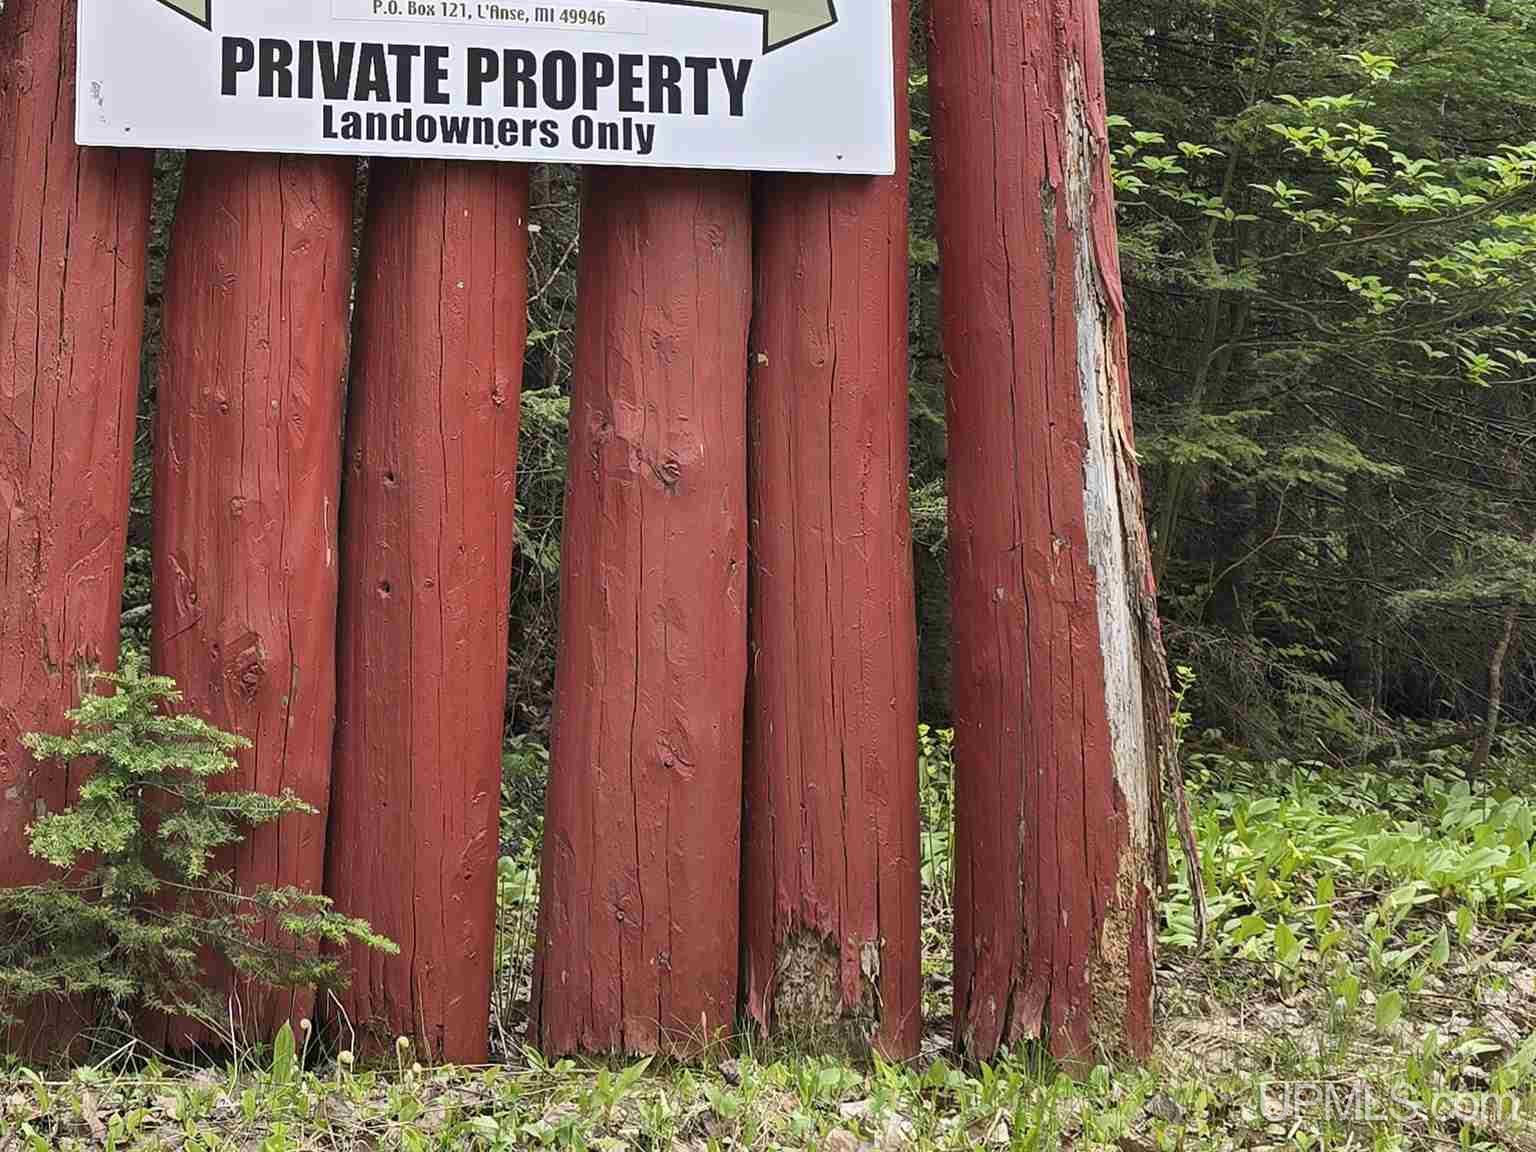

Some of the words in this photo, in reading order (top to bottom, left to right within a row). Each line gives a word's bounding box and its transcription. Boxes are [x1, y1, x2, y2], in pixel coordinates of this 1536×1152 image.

[372, 0, 403, 16] P.O.
[407, 0, 436, 17] Box
[441, 1, 472, 21] 121,
[476, 4, 530, 24] L'Anse,
[534, 7, 555, 23] MI
[559, 7, 606, 26] 49946
[220, 36, 450, 105] PRIVATE
[466, 47, 753, 117] PROPERTY
[322, 104, 560, 147] Landowners
[571, 114, 656, 155] Only
